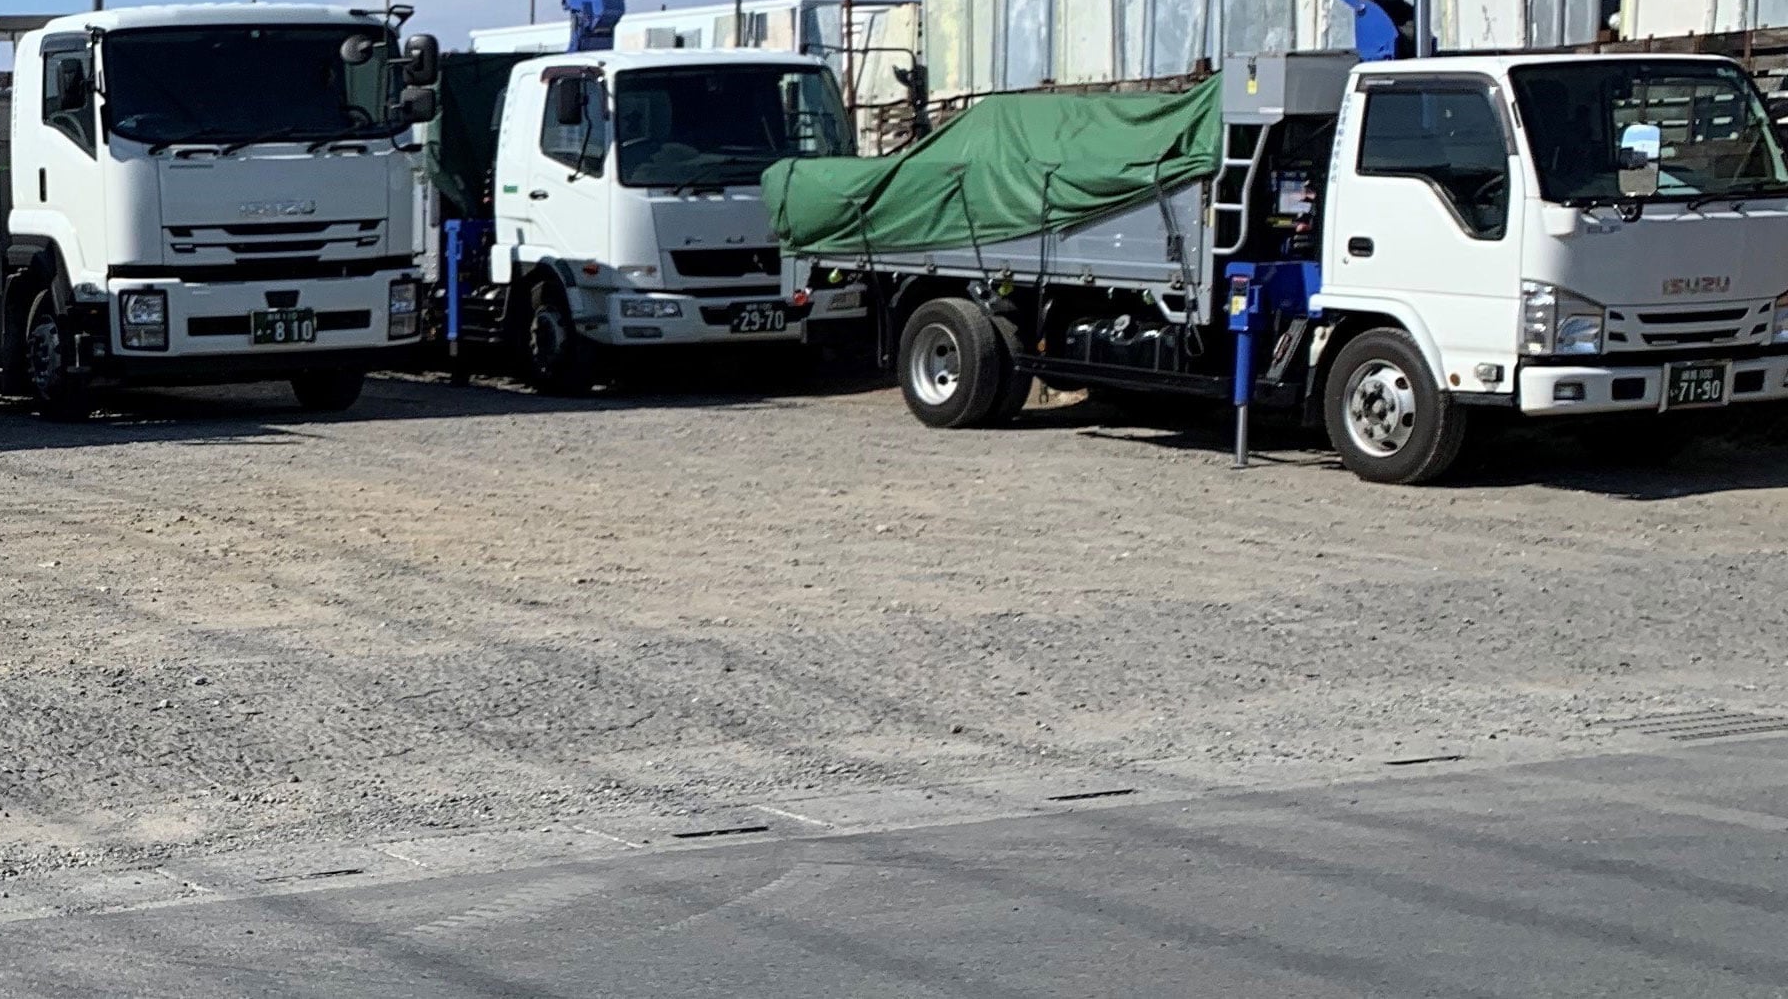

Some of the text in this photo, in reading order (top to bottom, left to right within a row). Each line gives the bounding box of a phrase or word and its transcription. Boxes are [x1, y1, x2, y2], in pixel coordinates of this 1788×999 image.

[1663, 276, 1730, 295] ISUZU
[740, 310, 784, 331] 29-70
[1678, 380, 1721, 401] 71-90
